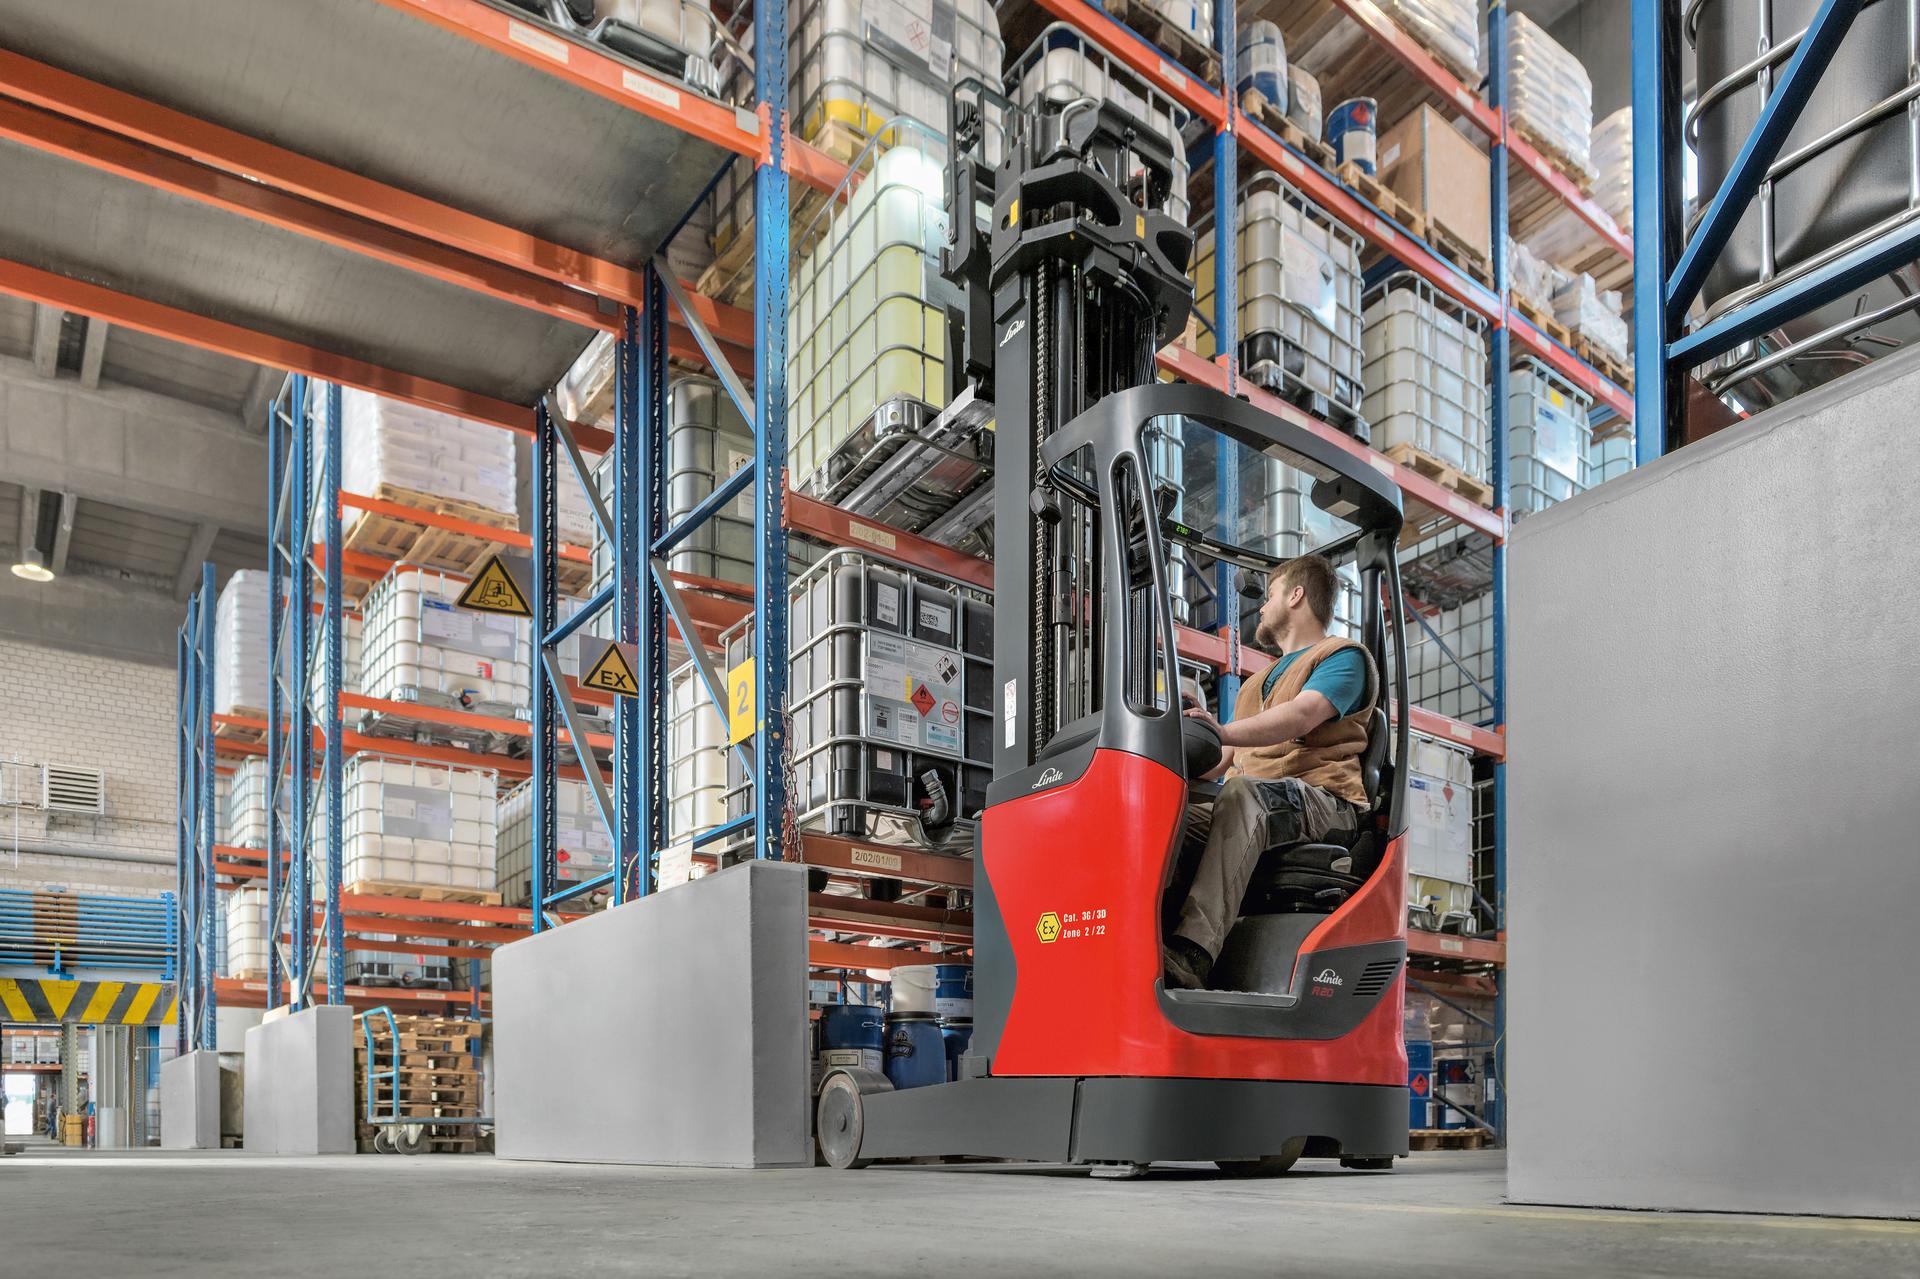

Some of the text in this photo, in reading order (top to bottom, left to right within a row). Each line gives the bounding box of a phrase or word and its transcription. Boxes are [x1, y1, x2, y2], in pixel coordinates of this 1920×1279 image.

[601, 670, 627, 688] EX
[736, 680, 749, 717] 2
[1031, 767, 1064, 789] Linde
[1063, 913, 1078, 923] Cat.
[1063, 928, 1081, 939] Zone
[1312, 968, 1343, 985] Linde
